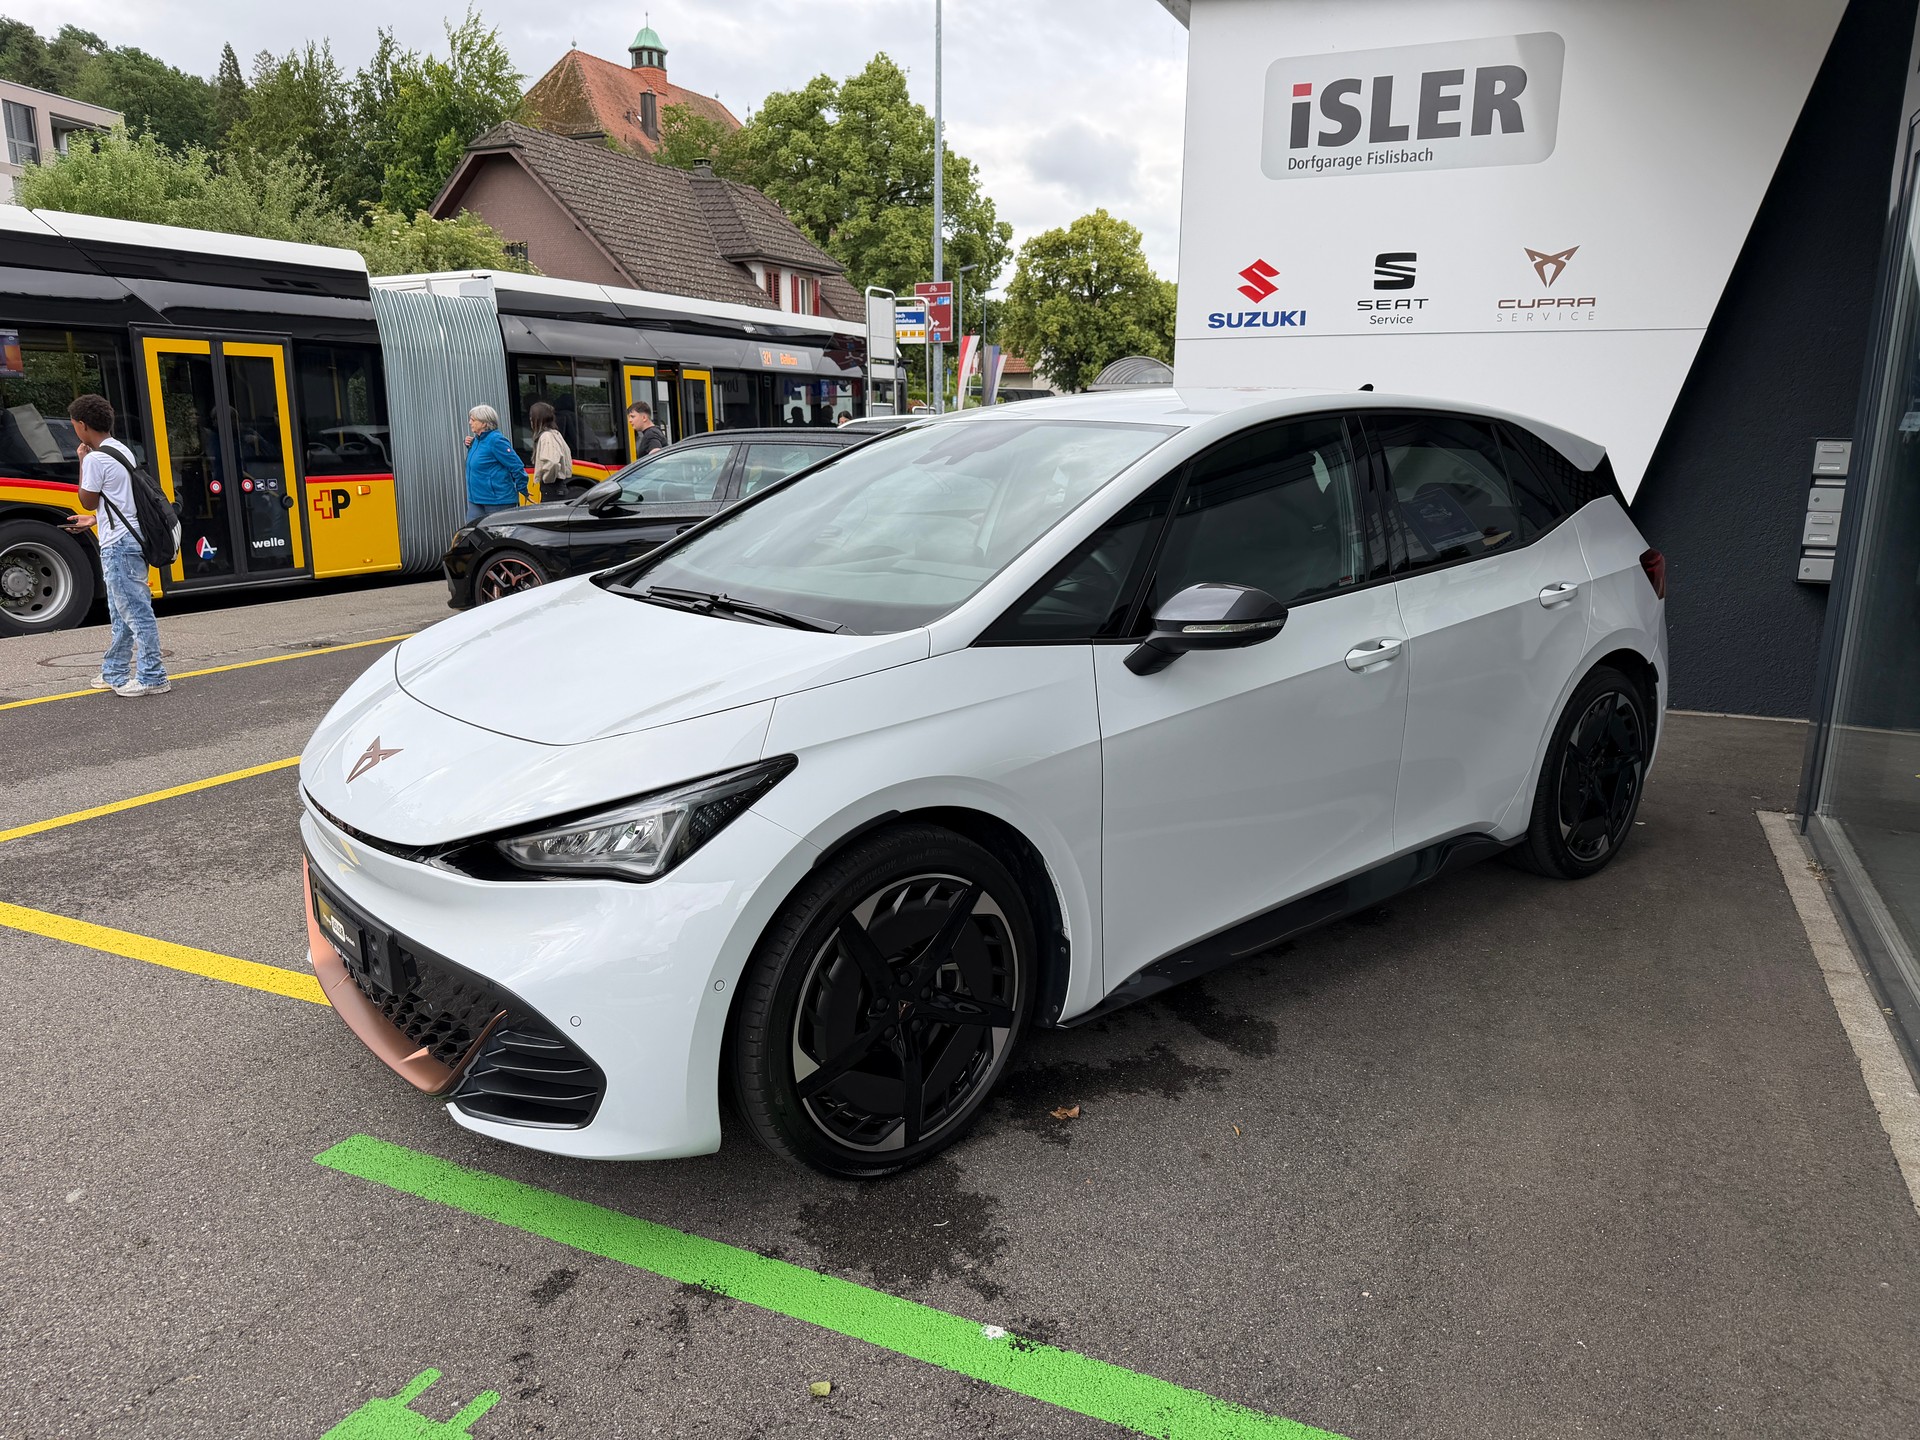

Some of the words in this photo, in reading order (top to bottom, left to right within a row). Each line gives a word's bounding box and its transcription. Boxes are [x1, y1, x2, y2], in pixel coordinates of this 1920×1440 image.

[1290, 65, 1528, 149] iSLER
[1288, 153, 1362, 172] Dorfgarage
[1367, 148, 1433, 166] Fislisbach
[1357, 298, 1429, 311] SEAT
[1498, 297, 1596, 310] CUPRA
[1207, 310, 1307, 329] SUZUKI
[1369, 314, 1414, 325] Service
[1496, 311, 1595, 323] SERVICE
[252, 537, 285, 549] welle
